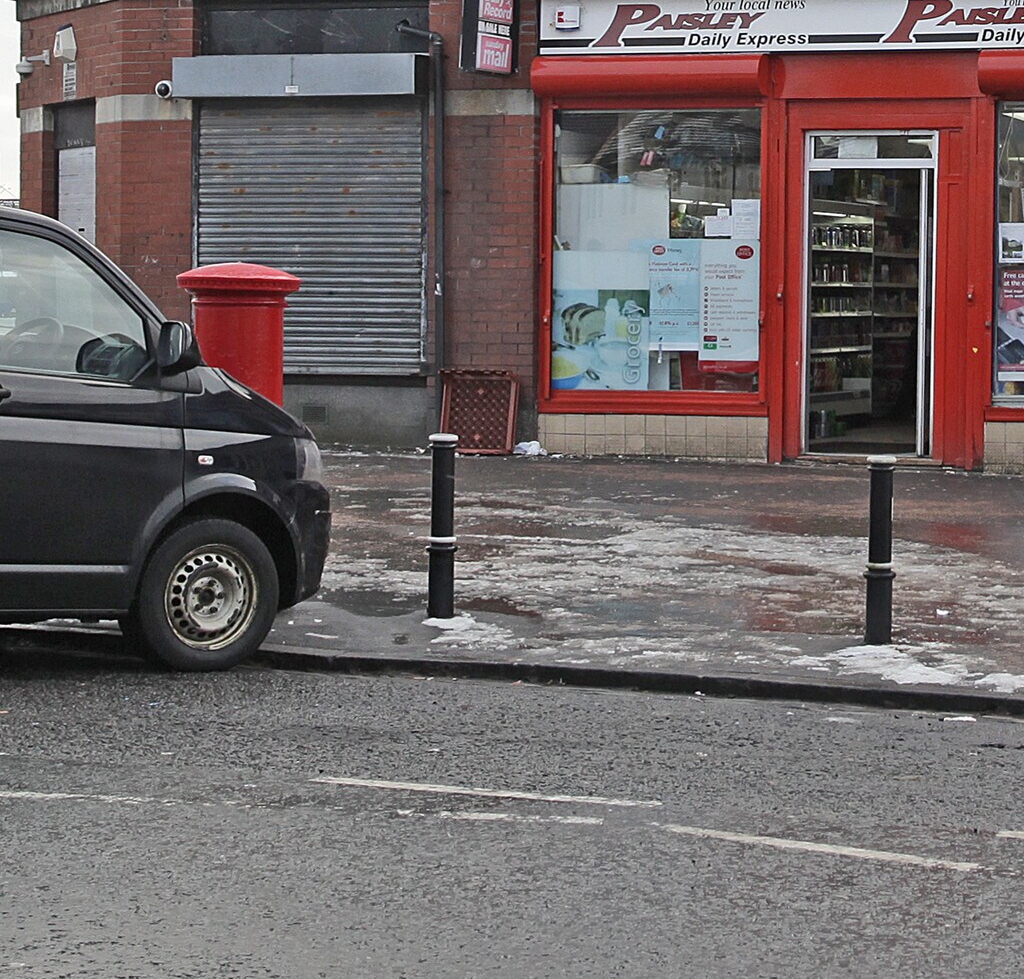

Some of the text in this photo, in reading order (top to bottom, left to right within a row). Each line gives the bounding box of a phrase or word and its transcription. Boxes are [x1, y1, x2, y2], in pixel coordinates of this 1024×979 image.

[484, 2, 513, 20] Record
[688, 32, 808, 49] Daily Express
[483, 43, 510, 68] mail
[623, 300, 646, 385] Grocery
